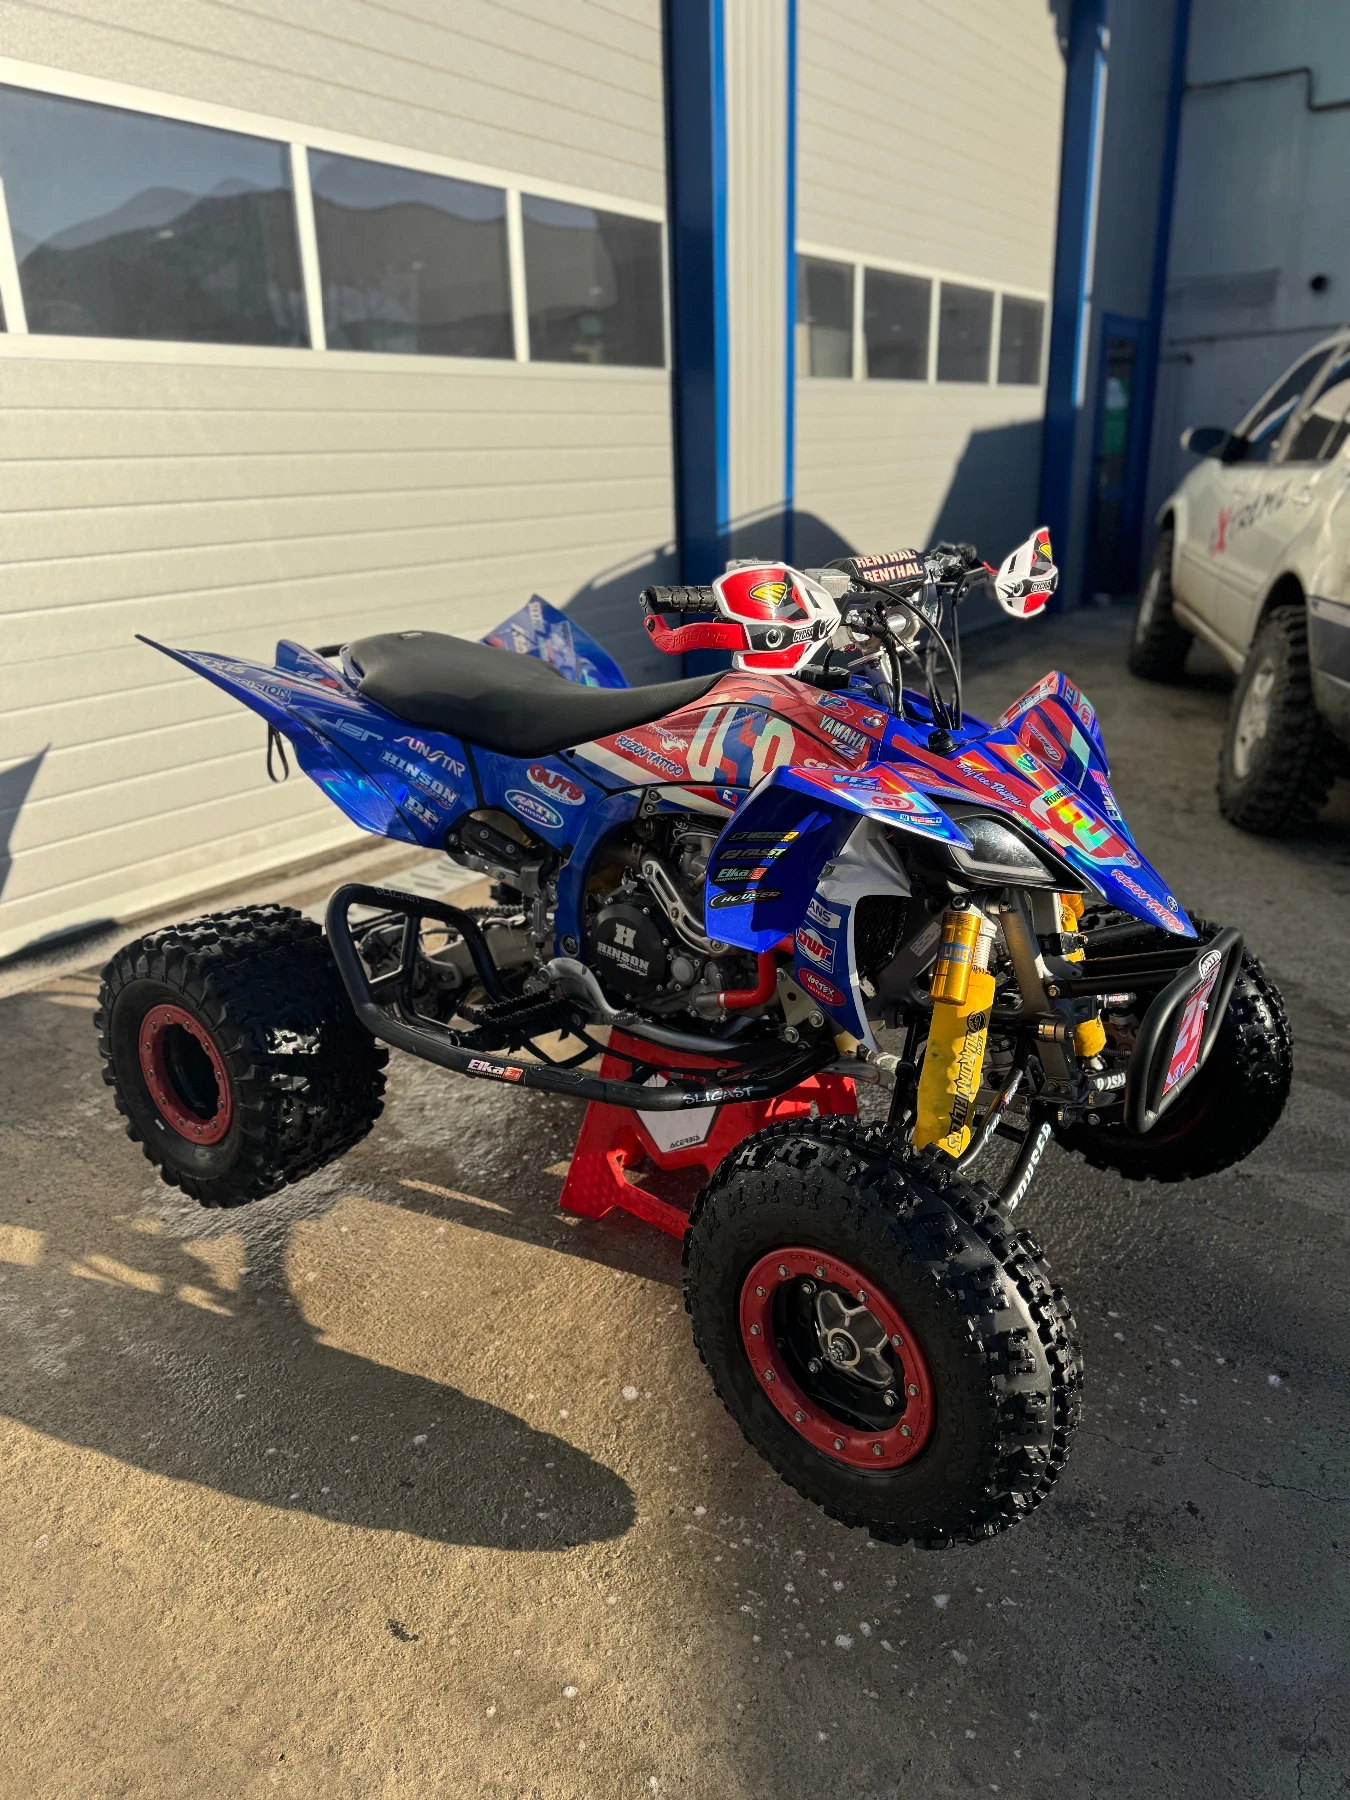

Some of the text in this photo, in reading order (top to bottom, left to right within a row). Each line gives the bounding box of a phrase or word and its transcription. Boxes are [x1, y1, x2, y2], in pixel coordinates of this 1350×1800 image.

[854, 550, 917, 568] RENTHAL
[863, 562, 923, 583] RENTHAL
[793, 627, 813, 642] CYCRA
[819, 714, 868, 752] YAMAHA
[380, 750, 458, 803] HINSON
[647, 751, 684, 777] TATTOO
[529, 764, 585, 800] GUTS
[973, 771, 991, 787] Lee
[990, 780, 1027, 808] Designs
[405, 795, 440, 825] DP
[871, 795, 903, 808] CST
[717, 867, 750, 879] Elka
[721, 891, 781, 903] HOUSER
[1146, 896, 1184, 932] TATTOO
[613, 922, 637, 950] H
[597, 941, 650, 971] HINSON
[806, 971, 835, 996] VORTEX
[468, 1059, 505, 1075] Elka
[669, 1135, 701, 1149] ACERBIS
